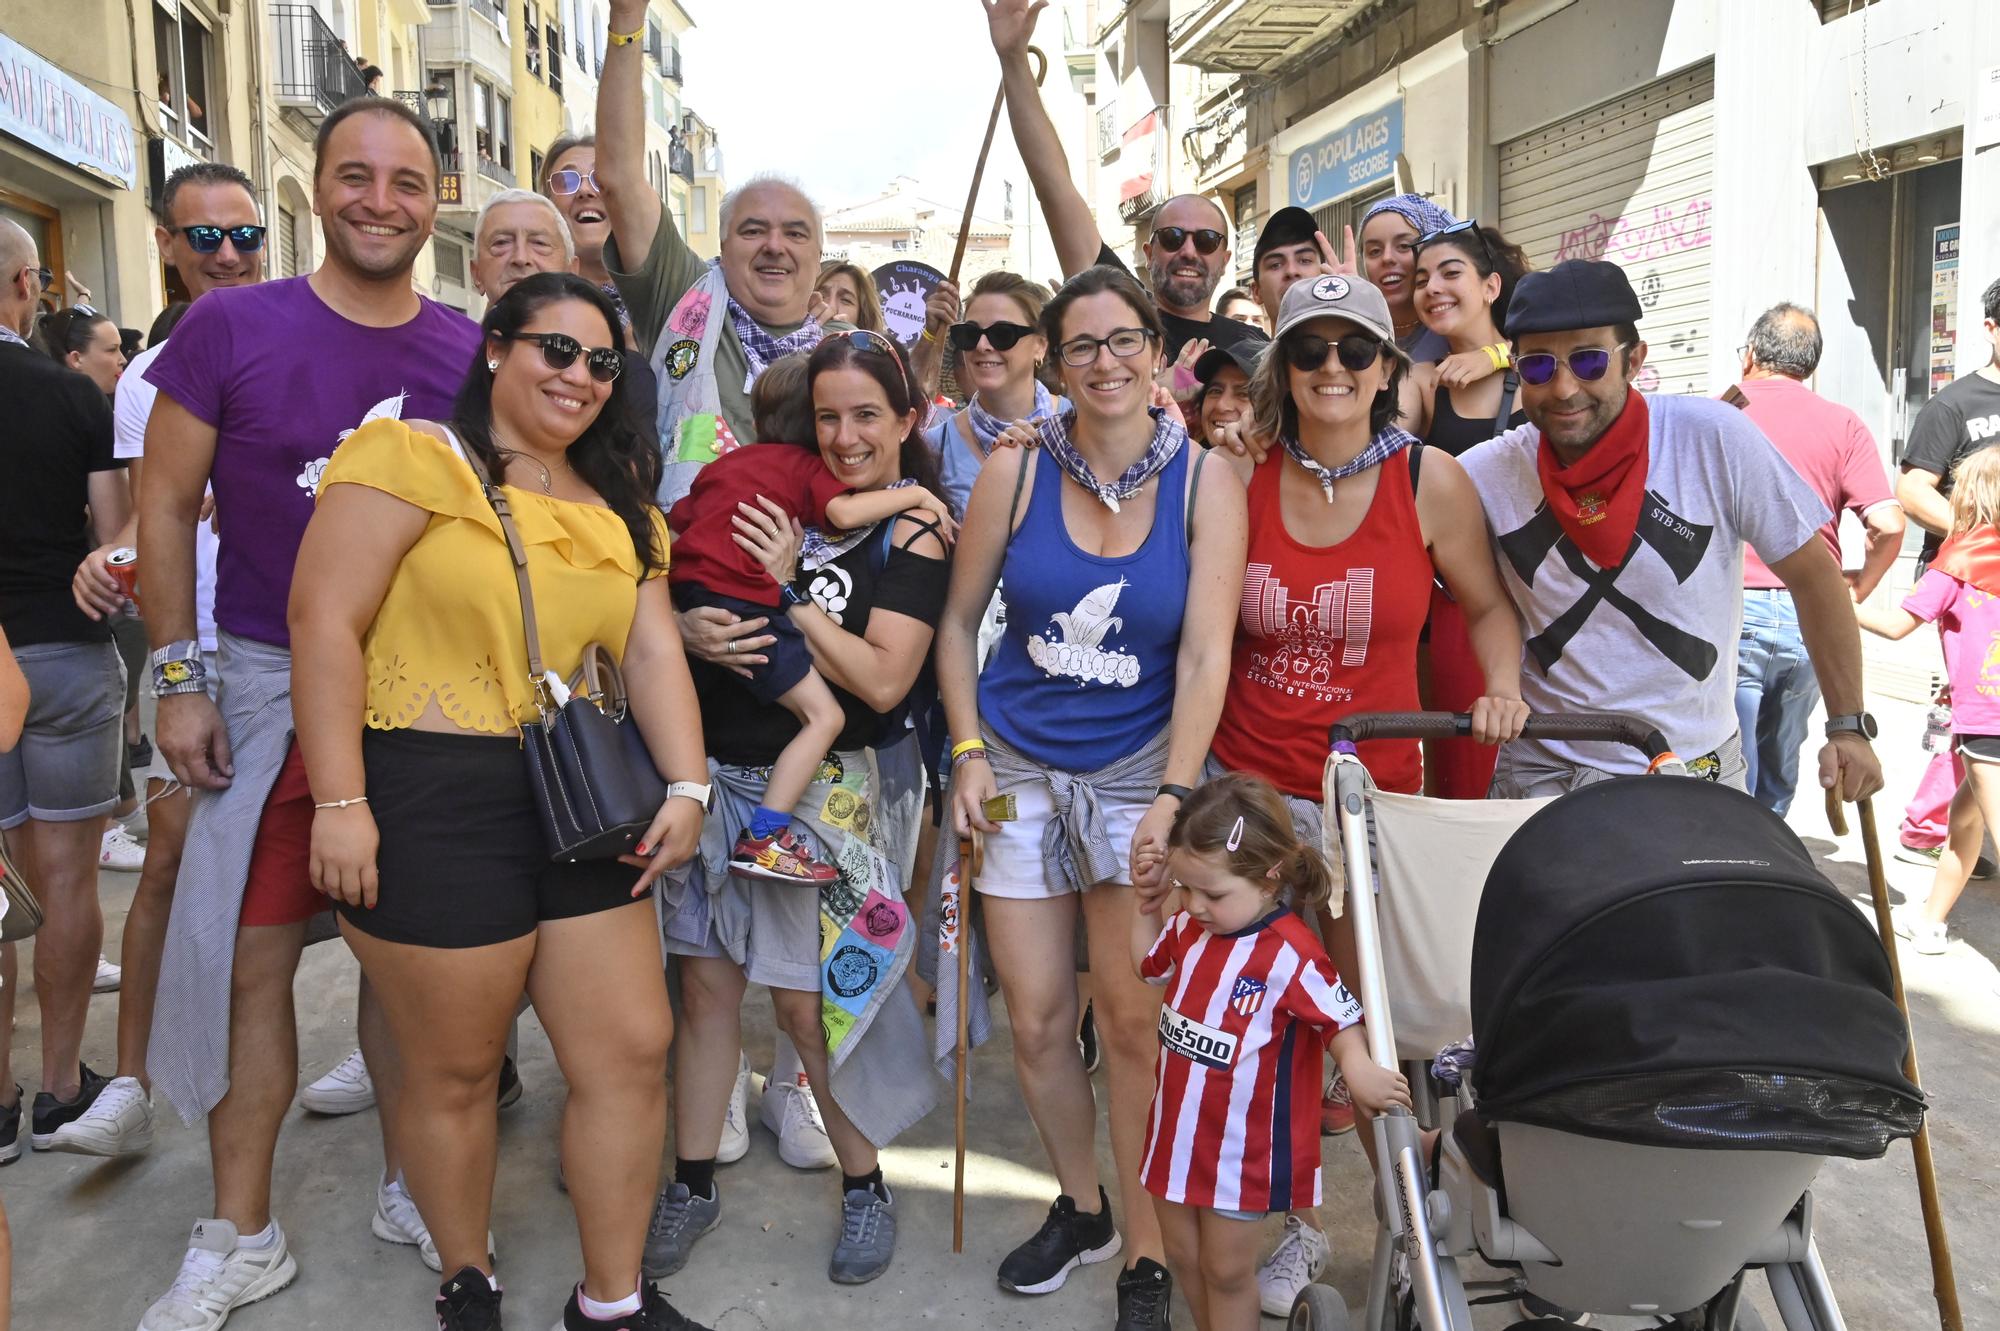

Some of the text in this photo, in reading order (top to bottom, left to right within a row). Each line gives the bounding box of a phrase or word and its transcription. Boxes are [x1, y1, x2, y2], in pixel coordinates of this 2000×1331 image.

[0, 57, 131, 174] MUEBLES
[1318, 116, 1389, 174] POPULARES
[1348, 150, 1389, 183] SEGORBE
[896, 264, 940, 284] Charanga
[904, 302, 912, 310] LA
[1651, 507, 1695, 541] STB 2017
[1247, 671, 1352, 702] SEGORBE 2015
[772, 855, 800, 875] 95
[1160, 1011, 1231, 1060] Plus500
[1176, 1046, 1198, 1061] Online
[1394, 1161, 1415, 1237] bébéconfort
